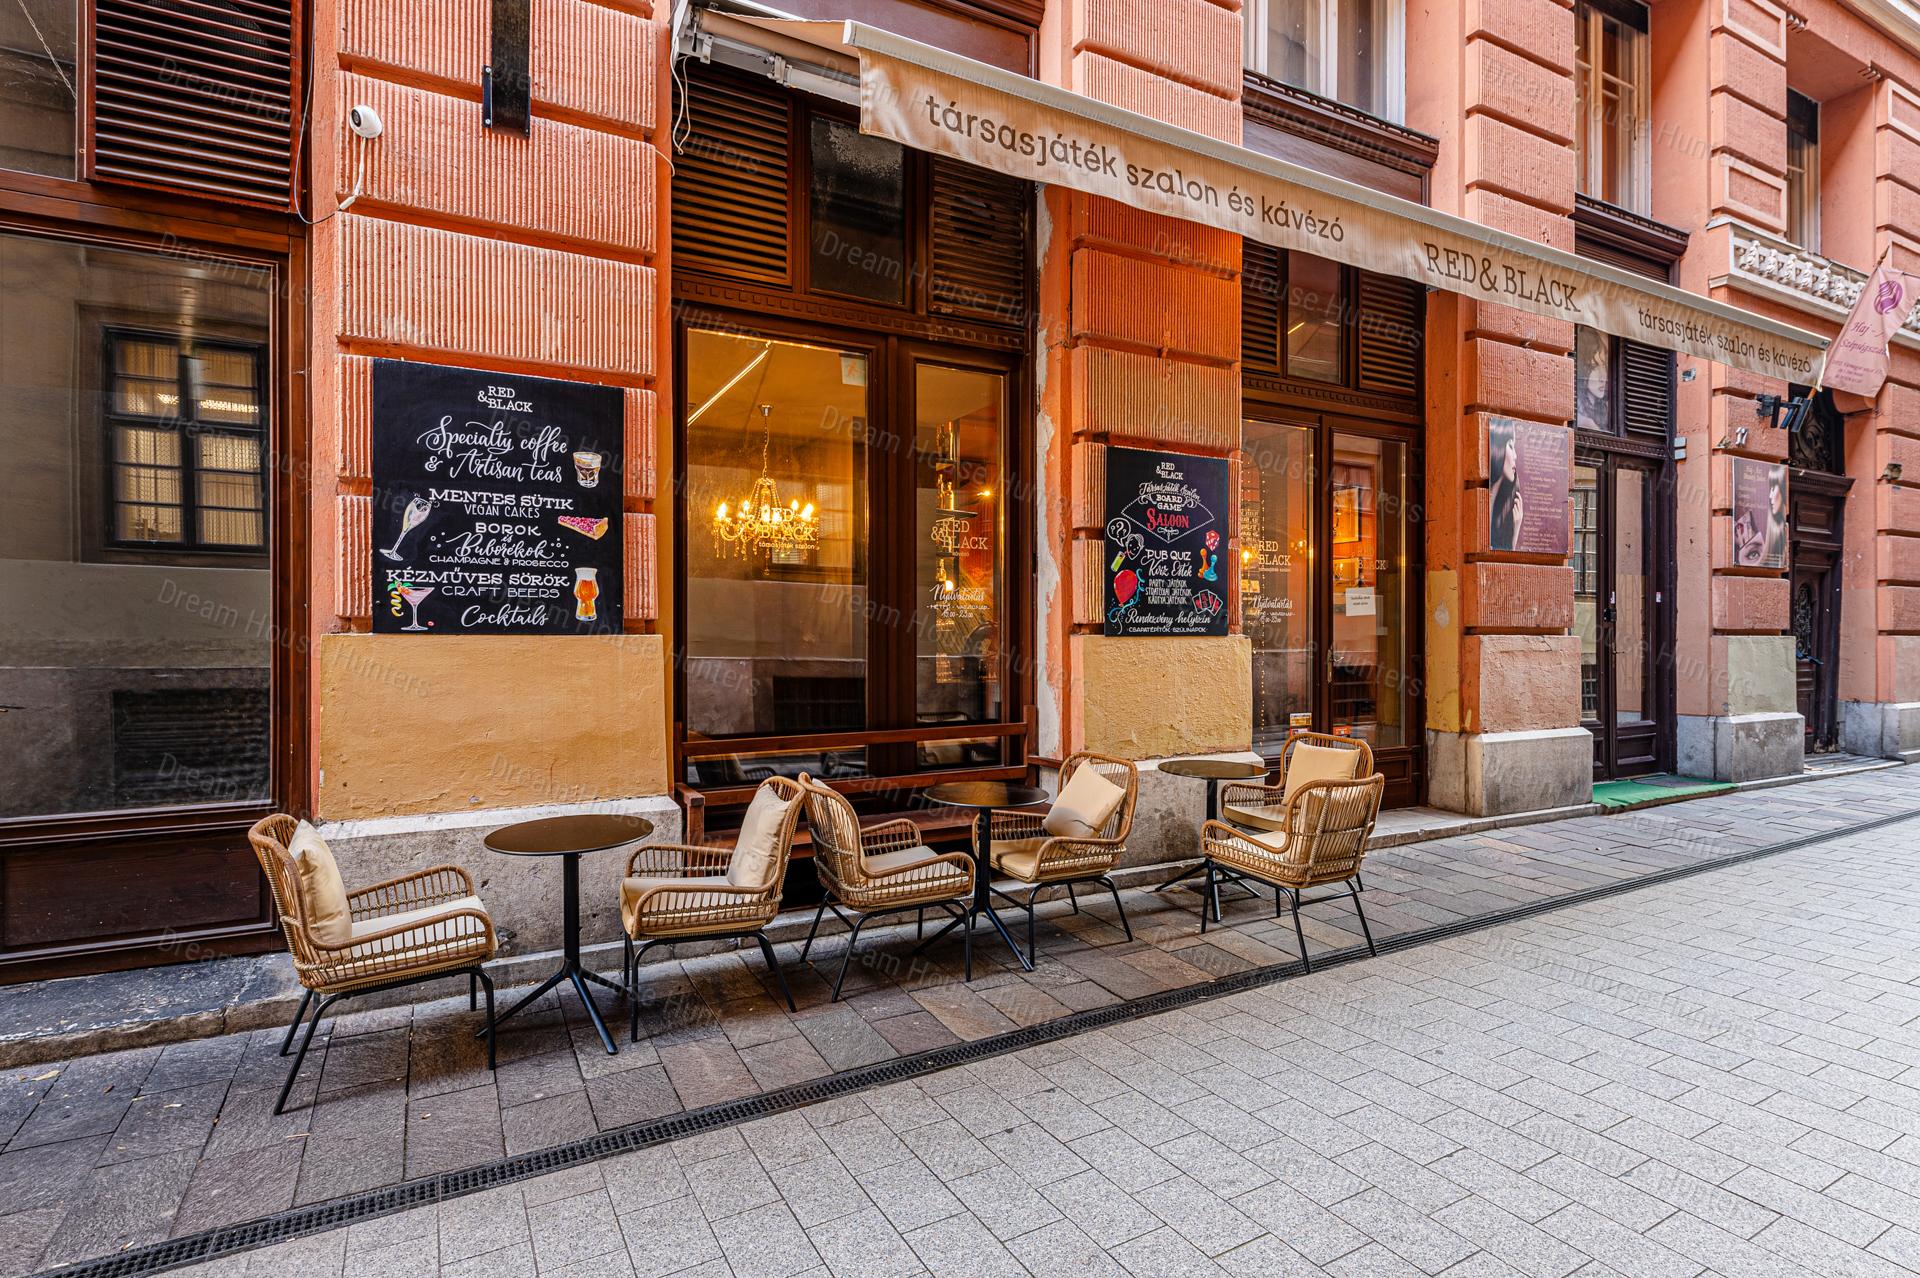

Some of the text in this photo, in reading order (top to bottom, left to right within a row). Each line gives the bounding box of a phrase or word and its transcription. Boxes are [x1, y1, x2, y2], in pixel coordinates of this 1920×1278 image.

[925, 94, 1344, 243] társasjáték szalon és kávézó
[1638, 307, 1714, 348] társasjáték
[1717, 334, 1755, 359] szalon
[1758, 341, 1771, 363] és
[1773, 342, 1812, 373] kávézó
[488, 386, 515, 398] RED
[417, 415, 567, 462] Specialty coffee
[425, 450, 562, 483] & Artisan teas
[1161, 462, 1175, 470] RED
[429, 488, 574, 510] MENTES SÜTIK
[1156, 494, 1182, 503] BOARD
[465, 504, 540, 518] VEGAN CAKES
[1157, 503, 1182, 511] GAME
[476, 523, 541, 536] BOROK
[446, 532, 555, 558] Buborékok
[1258, 541, 1278, 551] RED
[429, 555, 501, 565] CHAMPAGNE
[512, 559, 569, 567] PROSECCO
[1145, 549, 1191, 560] PUB QUIZ
[1258, 554, 1291, 566] BLACK
[386, 567, 570, 586] KÉZMŰVES SÖRÖK
[442, 586, 559, 598] CRAFT BEERS
[461, 604, 549, 627] Cocktails
